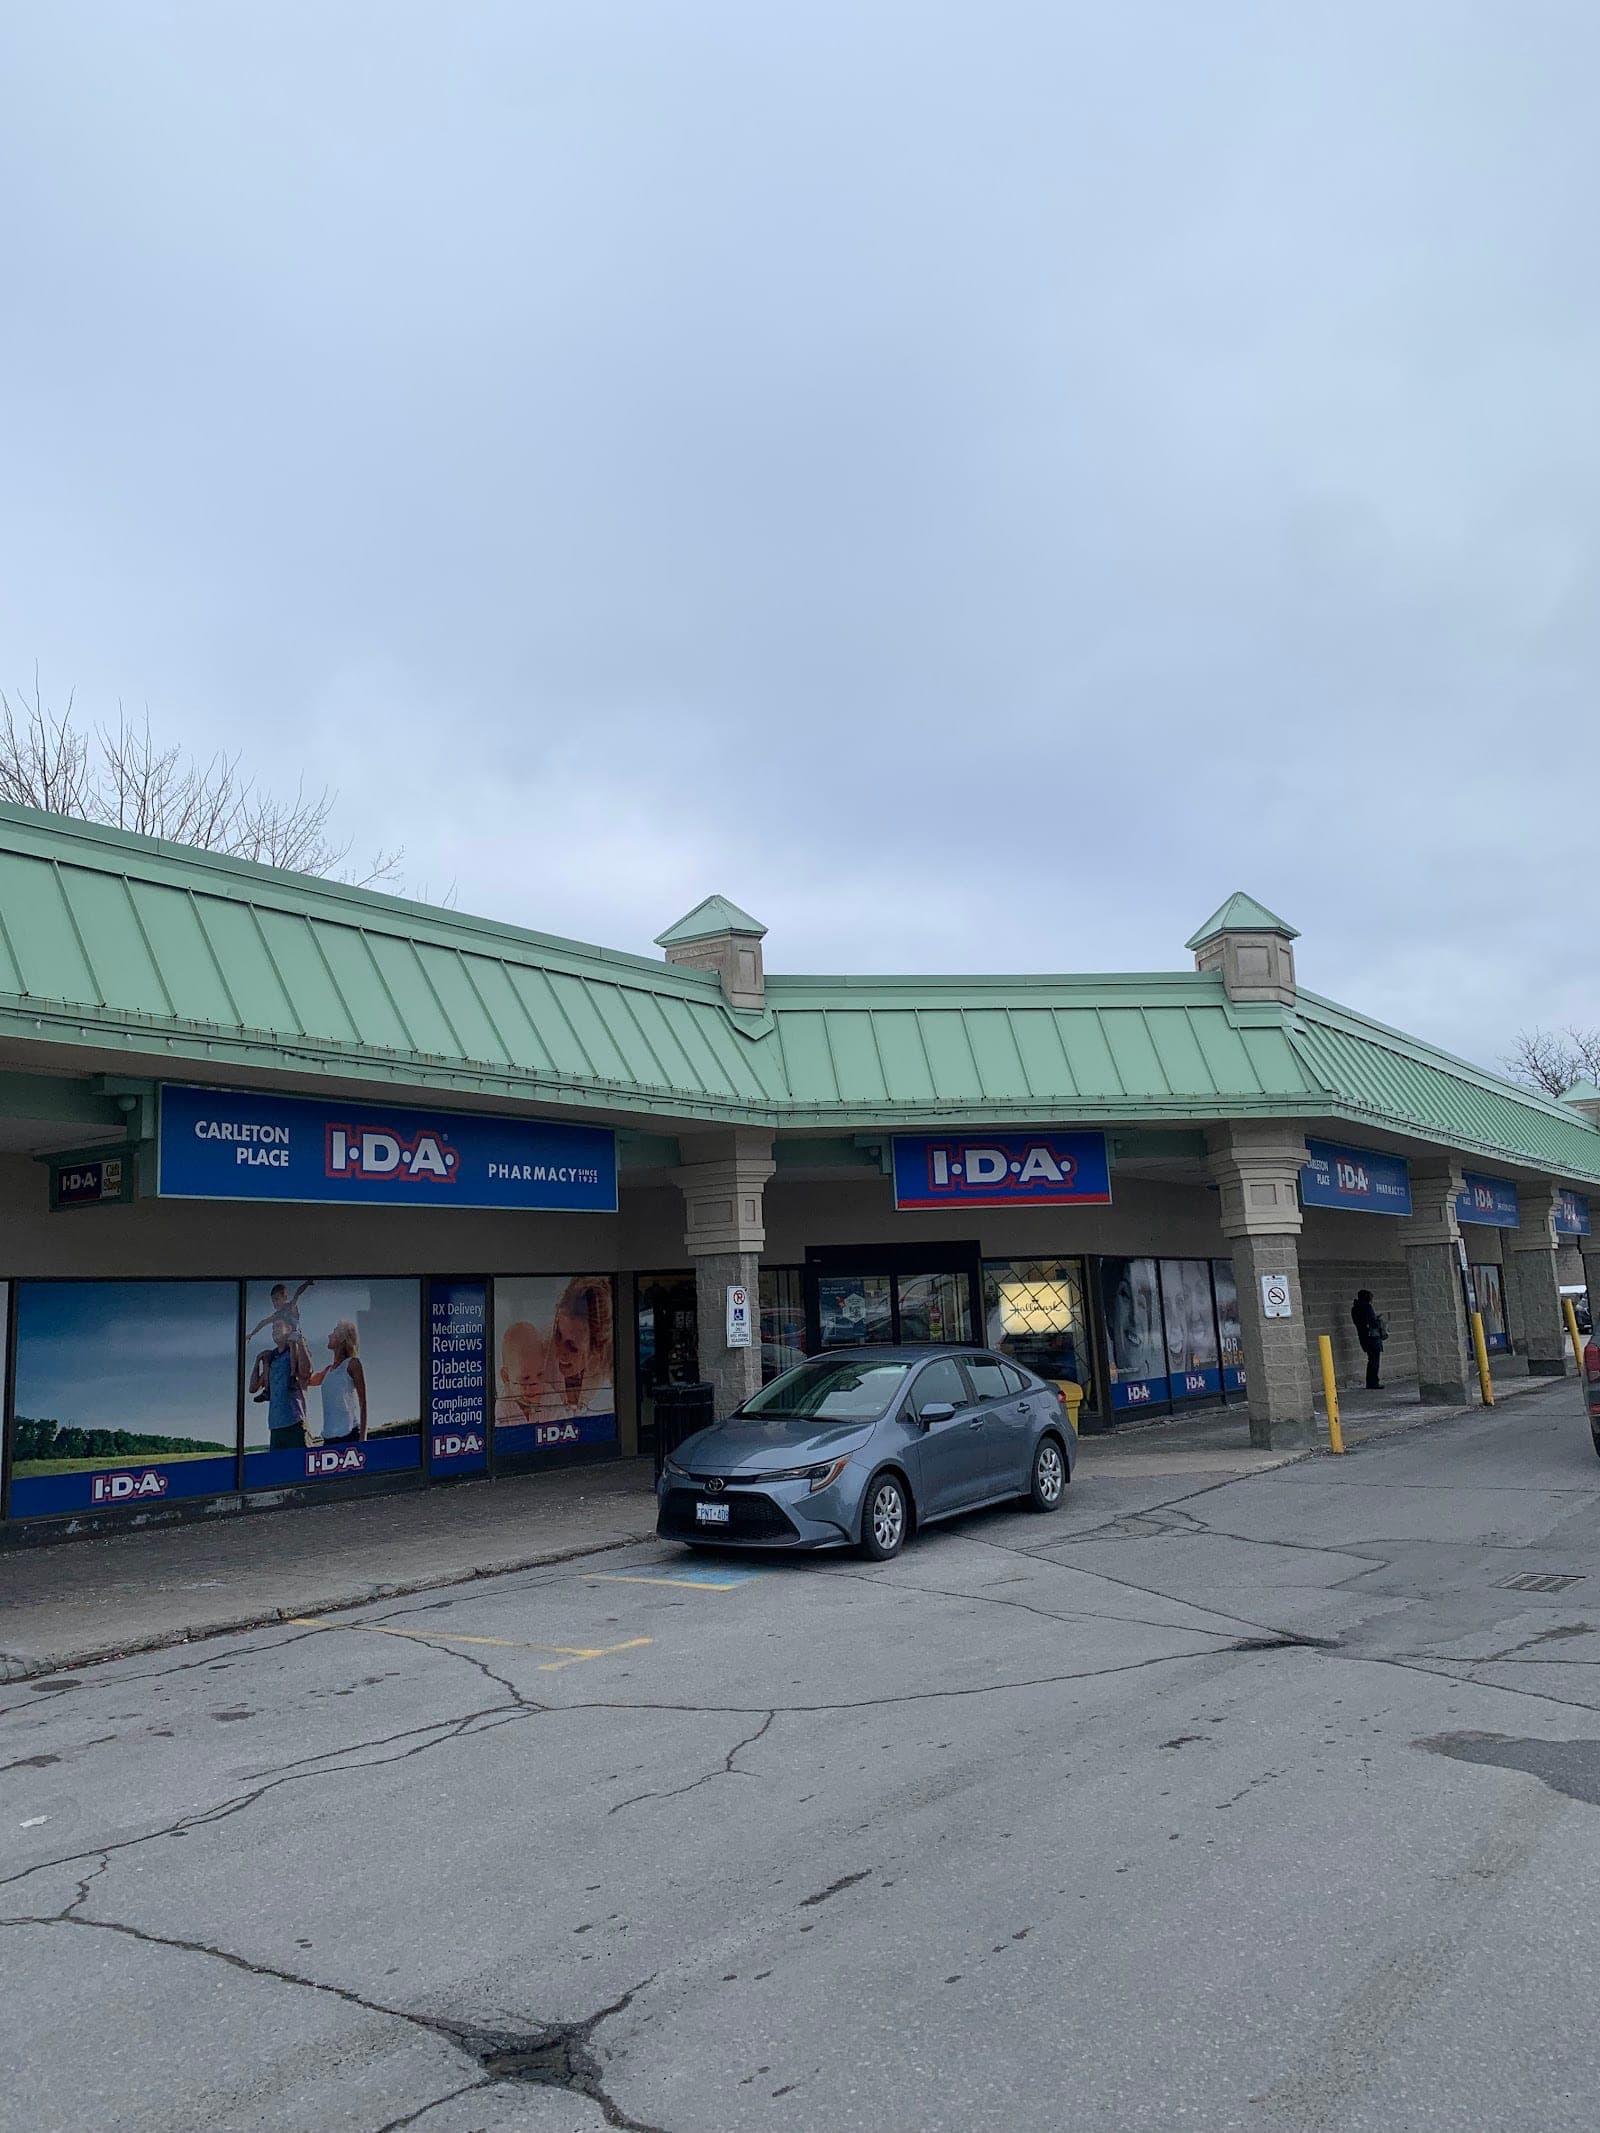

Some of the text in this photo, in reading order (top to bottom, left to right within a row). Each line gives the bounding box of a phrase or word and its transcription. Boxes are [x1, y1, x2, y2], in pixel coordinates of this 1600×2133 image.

[194, 1120, 290, 1144] CARLETON
[236, 1147, 290, 1167] PLACE
[488, 1163, 577, 1183] PHARMACY
[432, 1302, 483, 1318] RX Delivery
[432, 1321, 483, 1335] Medication
[432, 1335, 483, 1353] Reviews
[432, 1357, 483, 1375] Diabetes
[432, 1373, 483, 1391] Education
[432, 1395, 483, 1412] Compliance
[432, 1409, 483, 1426] Packaging
